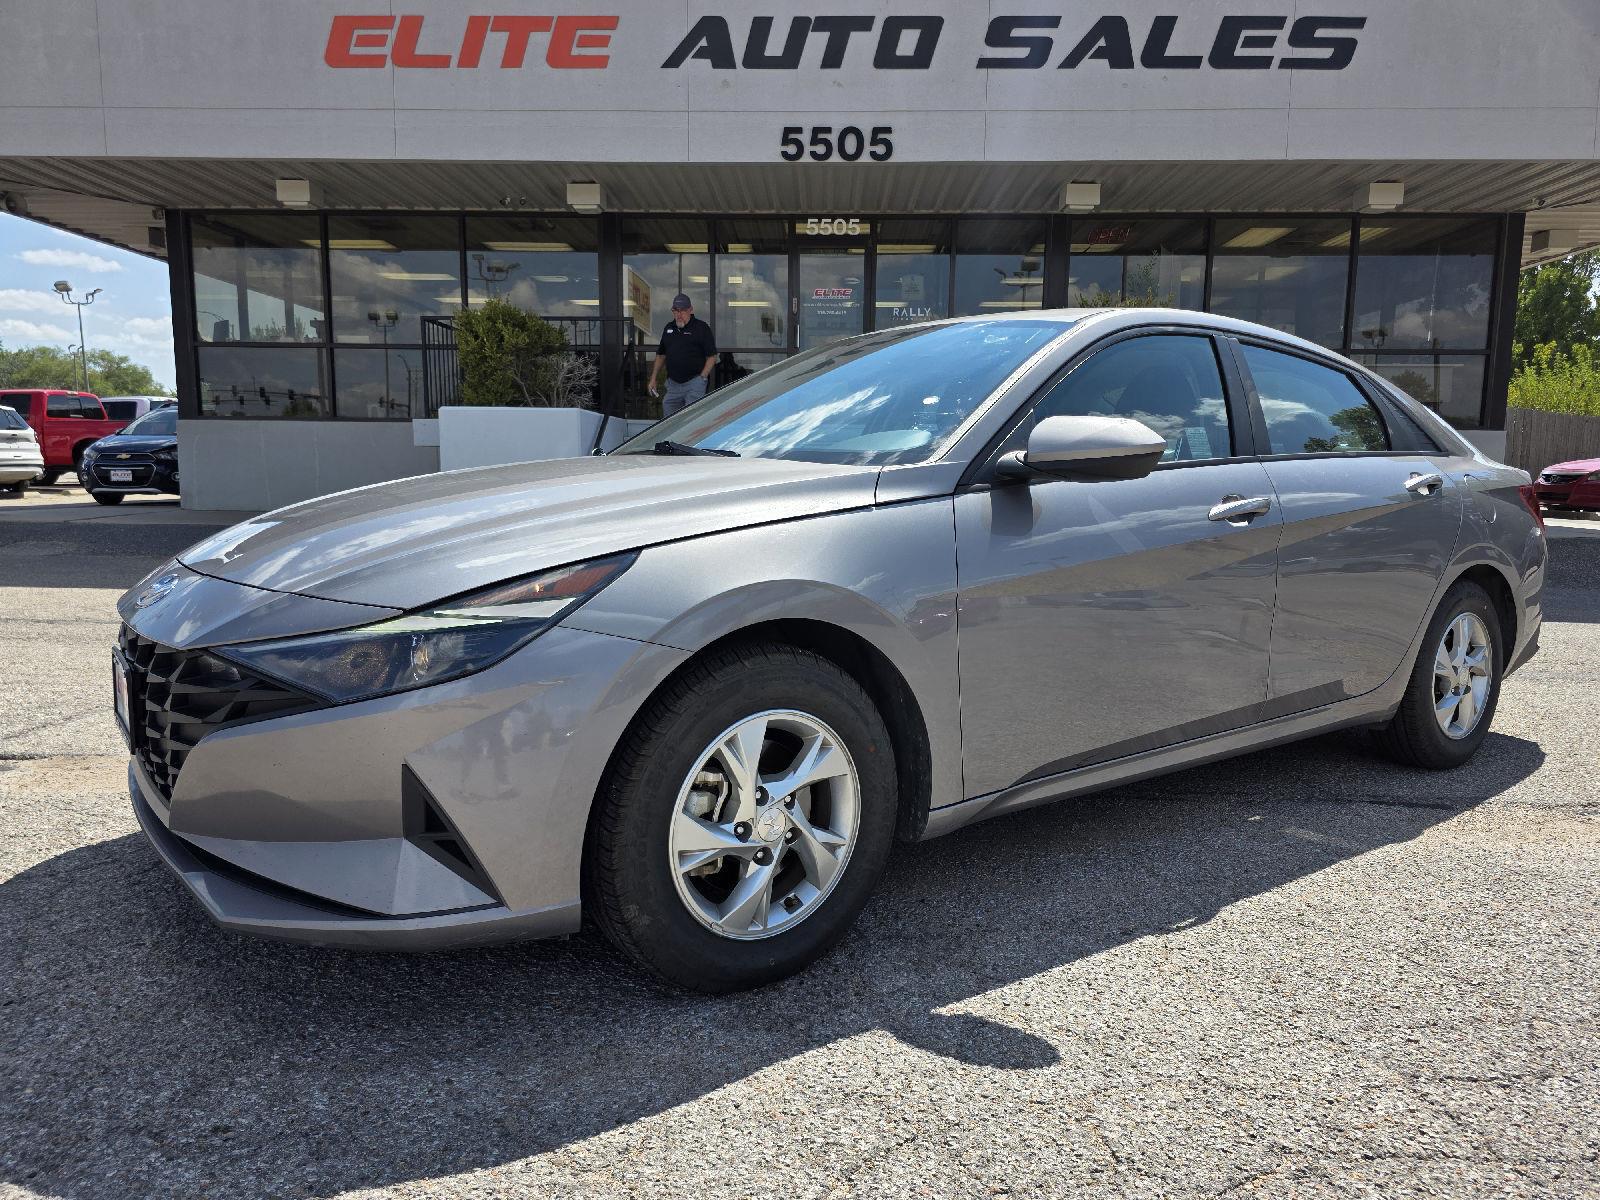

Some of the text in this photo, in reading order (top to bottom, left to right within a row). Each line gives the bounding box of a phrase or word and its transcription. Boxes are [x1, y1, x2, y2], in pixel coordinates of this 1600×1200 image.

[325, 16, 1367, 70] ELITE AUTO SALES
[781, 126, 893, 162] 5505
[806, 218, 861, 235] 5505
[814, 288, 852, 297] ELITE
[893, 307, 931, 317] RALLY
